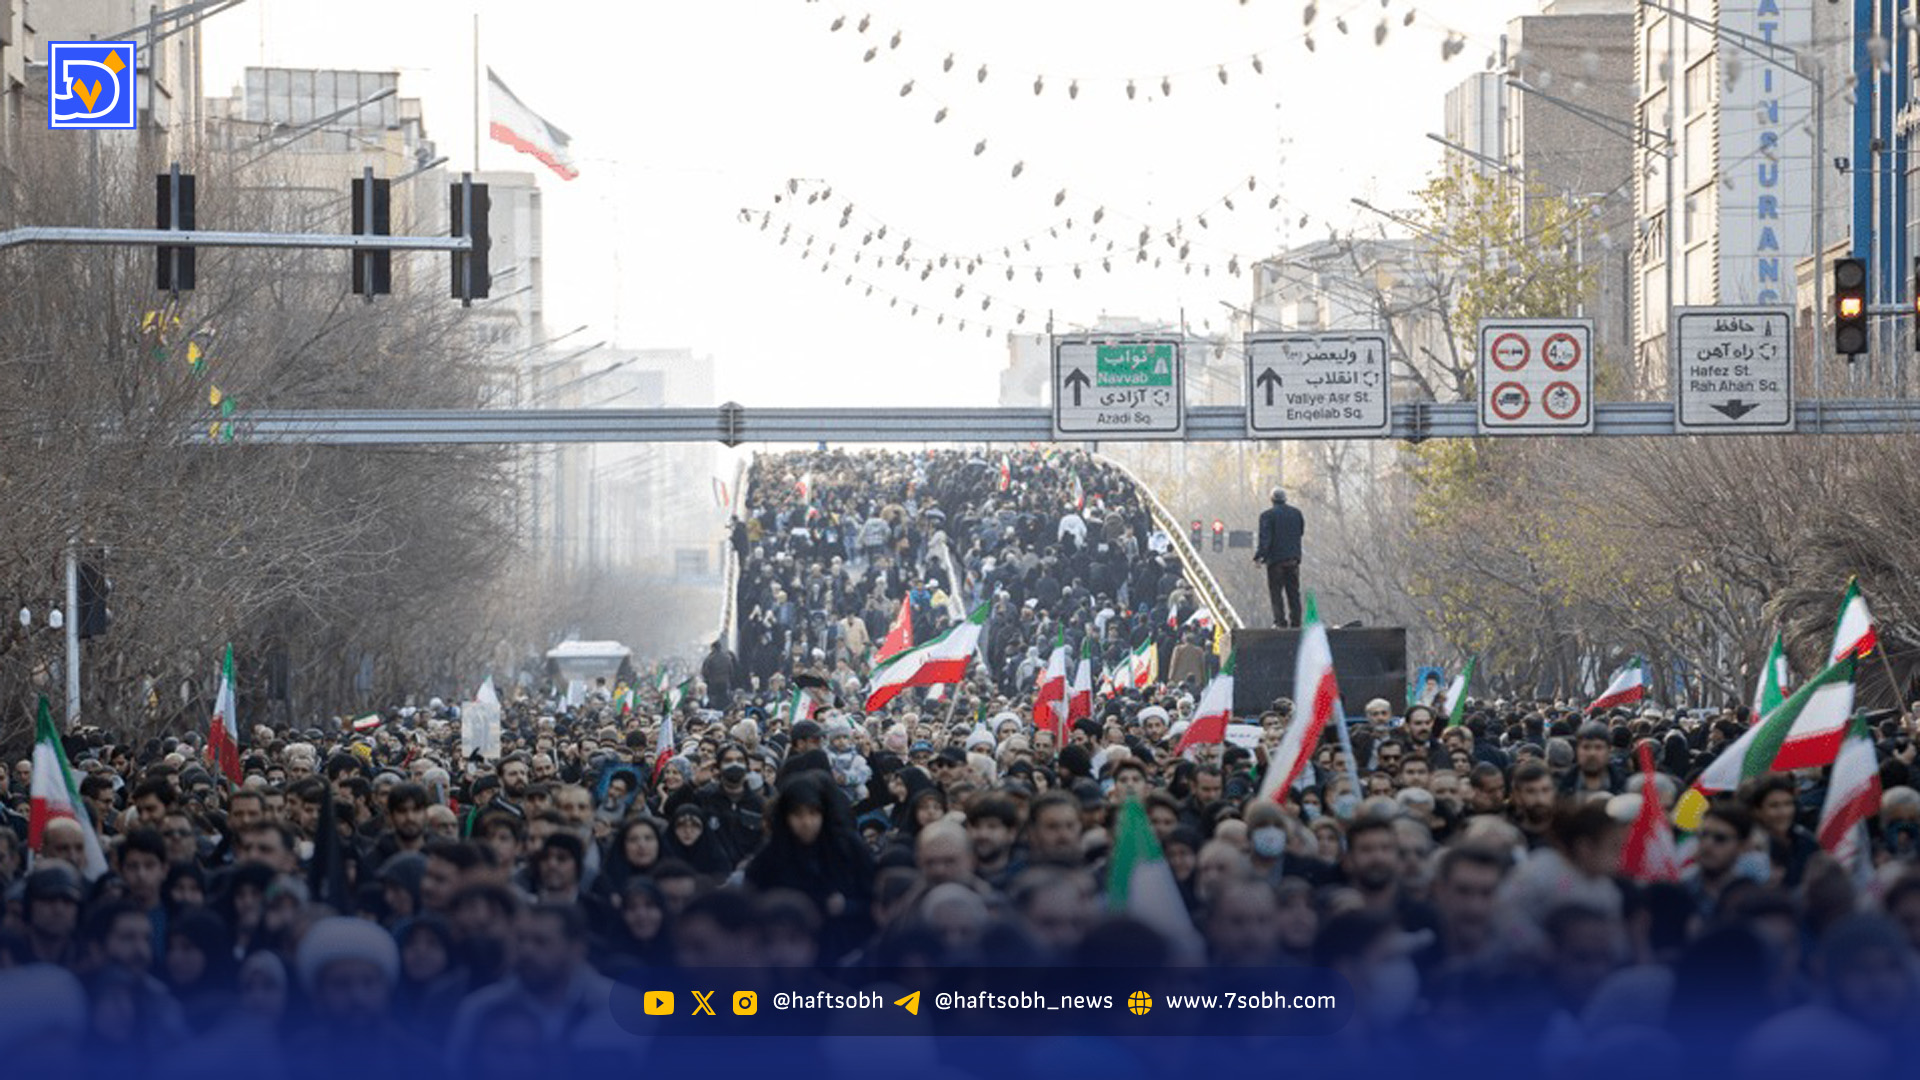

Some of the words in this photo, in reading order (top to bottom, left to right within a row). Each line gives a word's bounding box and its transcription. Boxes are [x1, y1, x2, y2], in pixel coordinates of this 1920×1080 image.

[1757, 69, 1779, 304] INSURANC
[1714, 317, 1754, 332] حافظ
[1104, 349, 1148, 370] نواب
[1302, 348, 1357, 366] ولیعصر
[1697, 342, 1731, 361] آهن
[1733, 344, 1754, 361] راه
[1097, 371, 1148, 384] Navvab
[1305, 371, 1358, 388] انقلاب
[1690, 366, 1729, 377] Hafez
[1690, 380, 1715, 392] Rah
[1719, 381, 1754, 392] Ahan
[1100, 388, 1147, 409] آزادی
[1329, 392, 1350, 404] Asr
[1097, 412, 1131, 424] Azadi
[1287, 408, 1341, 421] Enqelab
